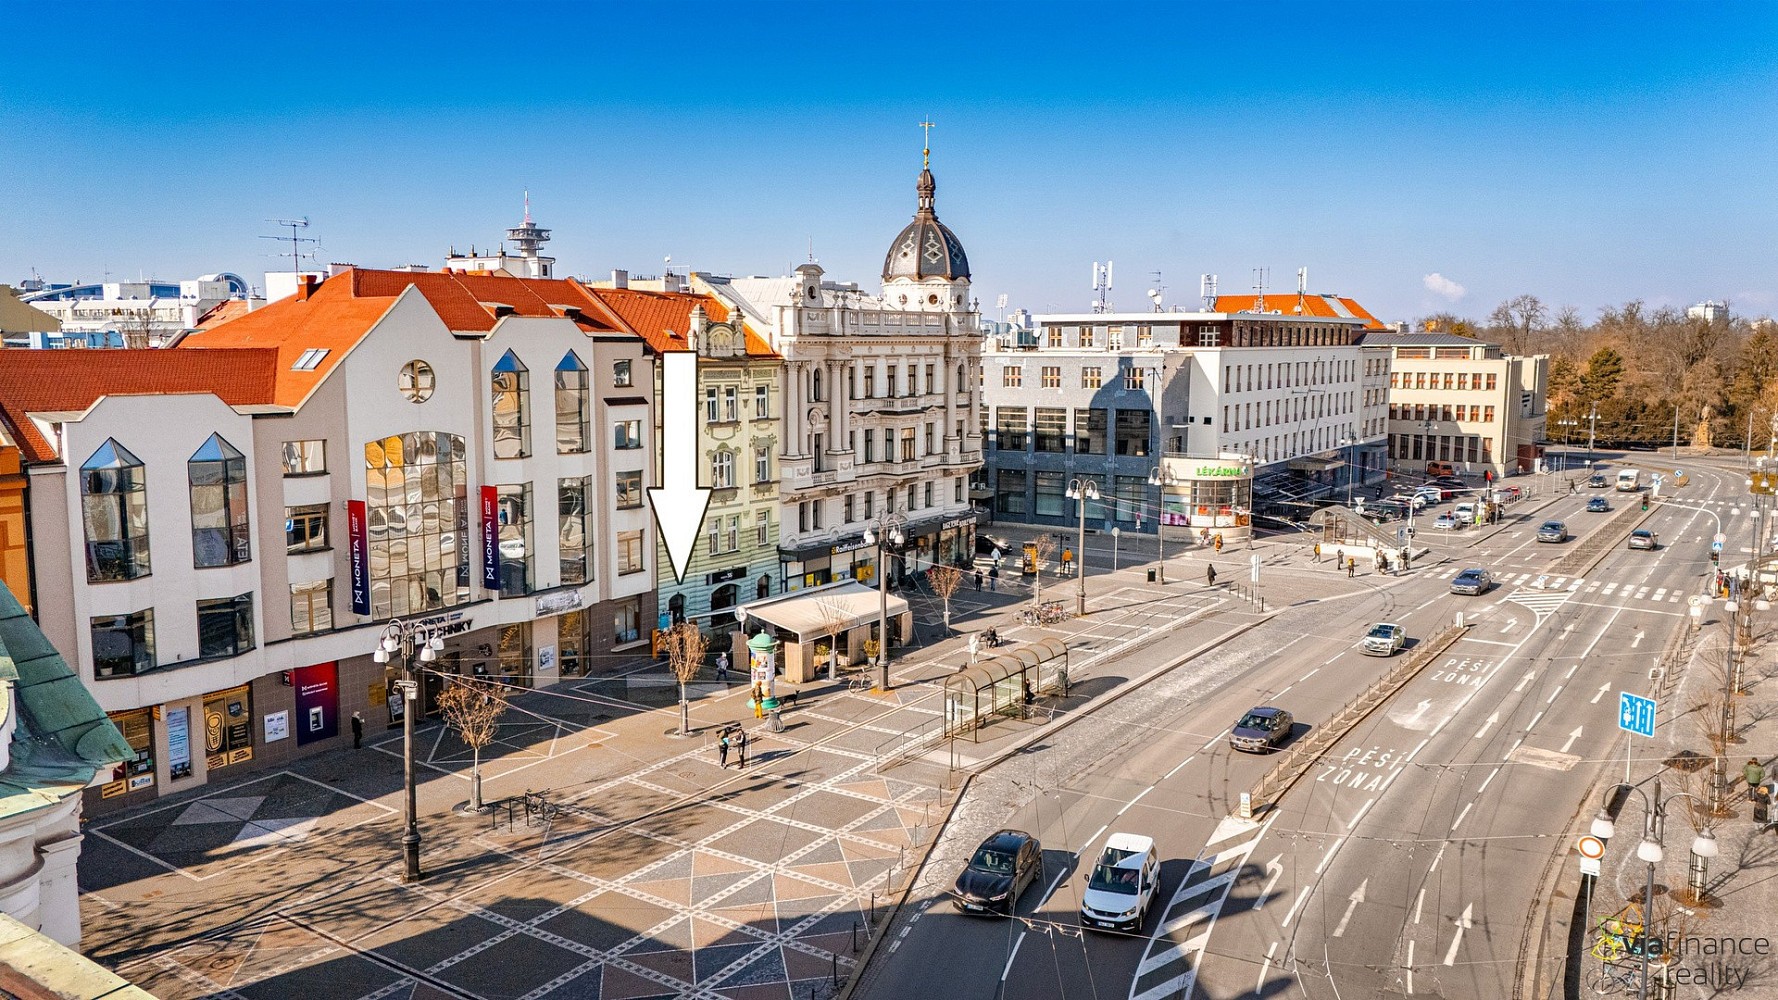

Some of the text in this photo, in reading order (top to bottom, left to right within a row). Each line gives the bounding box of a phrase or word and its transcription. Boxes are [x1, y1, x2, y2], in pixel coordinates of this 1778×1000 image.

[353, 539, 361, 587] MONETA
[420, 618, 474, 640] TECHNIKY
[1444, 657, 1494, 673] PĚŠÍ
[1431, 670, 1484, 687] ZÓNA
[1343, 746, 1408, 770] PĚŠÍ
[1317, 764, 1384, 792] ZÓNA
